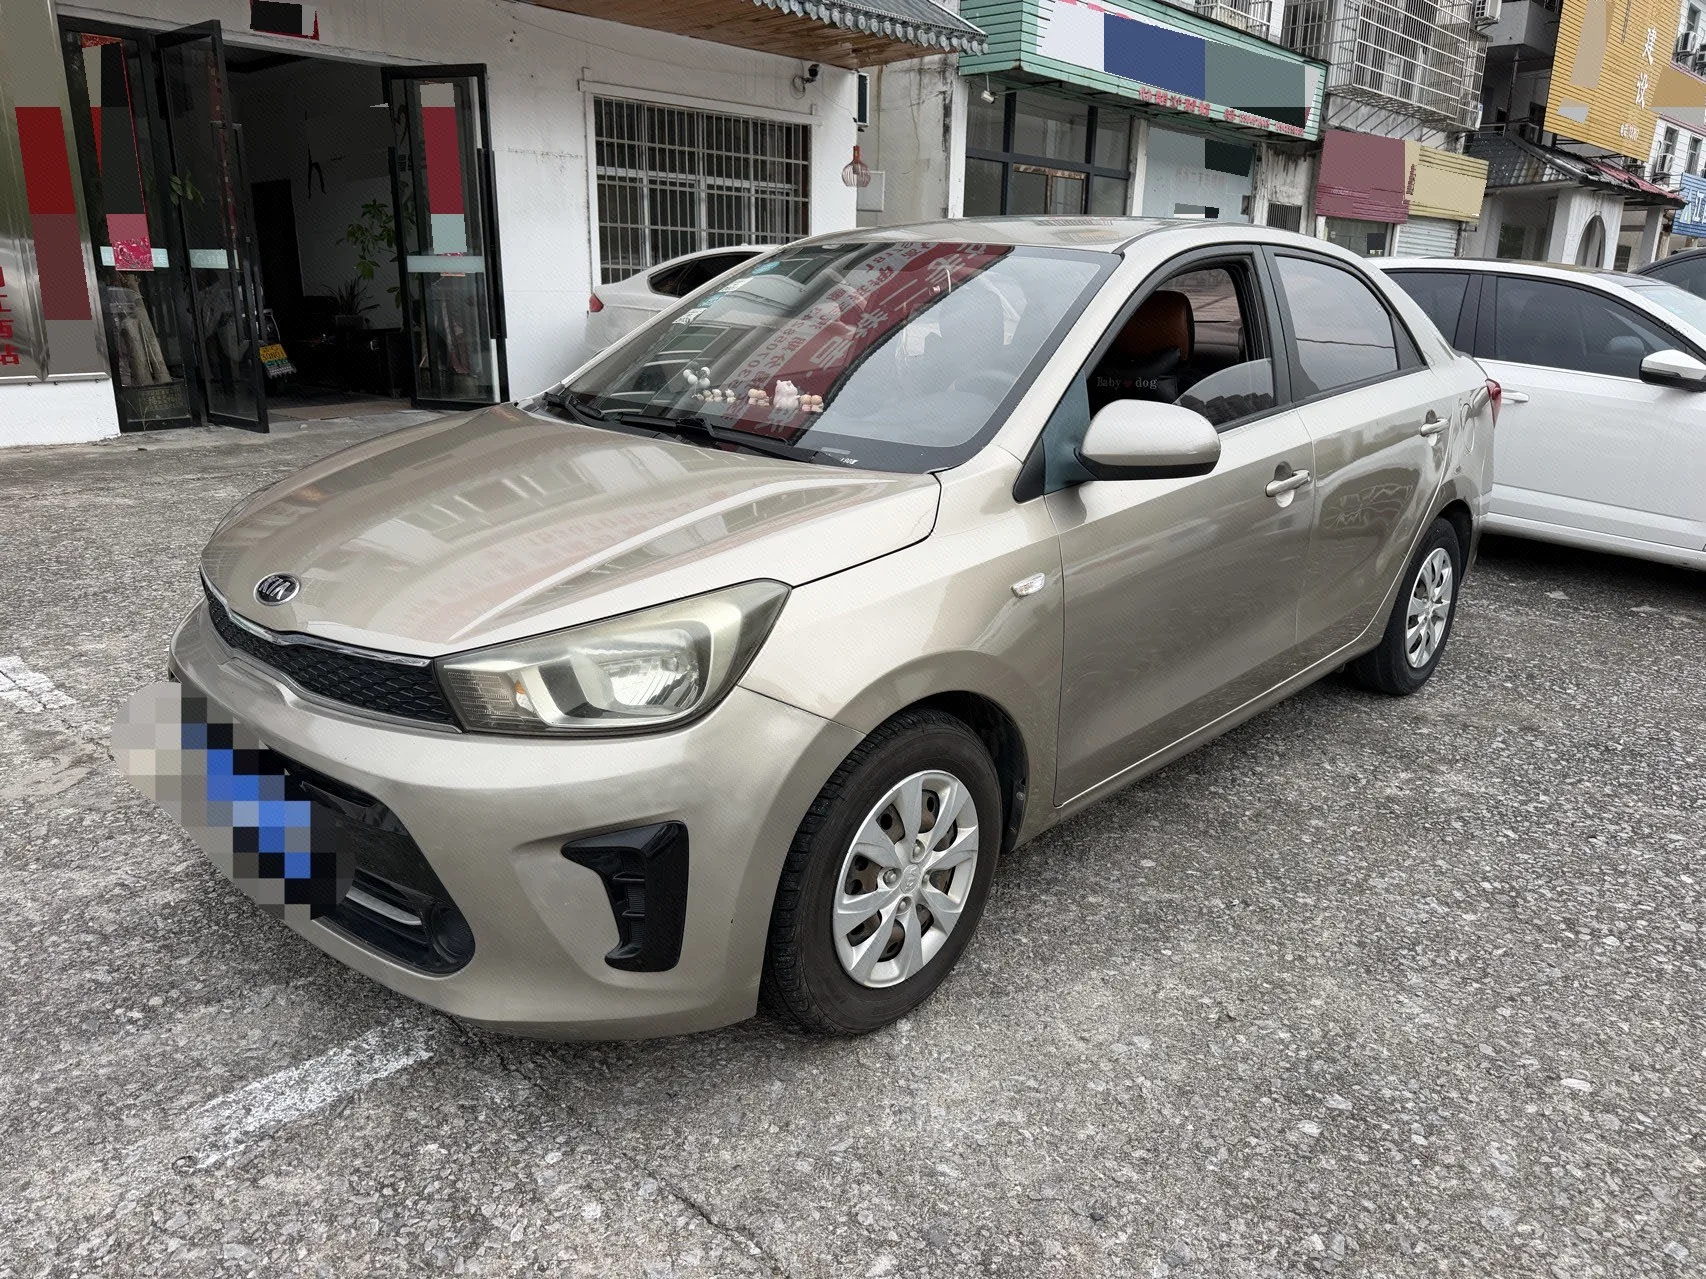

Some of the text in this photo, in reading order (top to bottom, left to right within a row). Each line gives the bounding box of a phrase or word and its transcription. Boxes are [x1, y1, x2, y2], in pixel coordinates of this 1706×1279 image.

[1096, 376, 1158, 391] Baby dog
[258, 576, 291, 600] KIA
